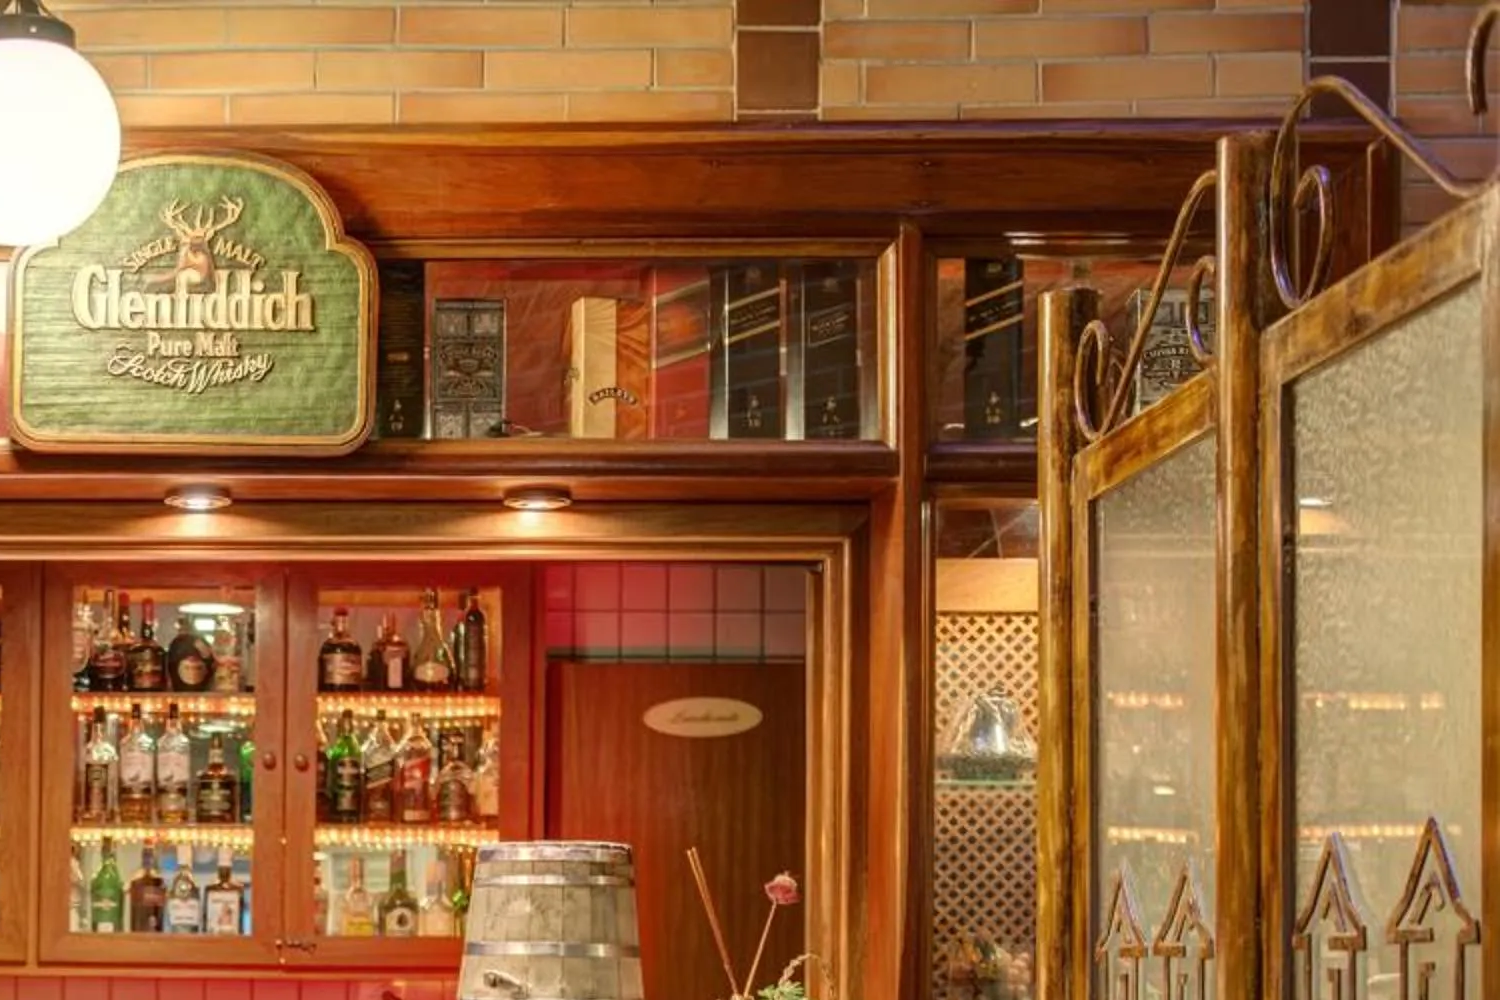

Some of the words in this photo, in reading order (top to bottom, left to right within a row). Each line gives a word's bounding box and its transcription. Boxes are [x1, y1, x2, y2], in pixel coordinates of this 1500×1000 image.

[123, 237, 178, 273] SINGLE
[214, 237, 266, 271] MALT
[71, 264, 315, 331] Glenfiddich
[148, 331, 192, 357] Pure
[195, 332, 240, 357] Malt
[108, 343, 188, 386] Scotch
[187, 353, 274, 394] Whisky
